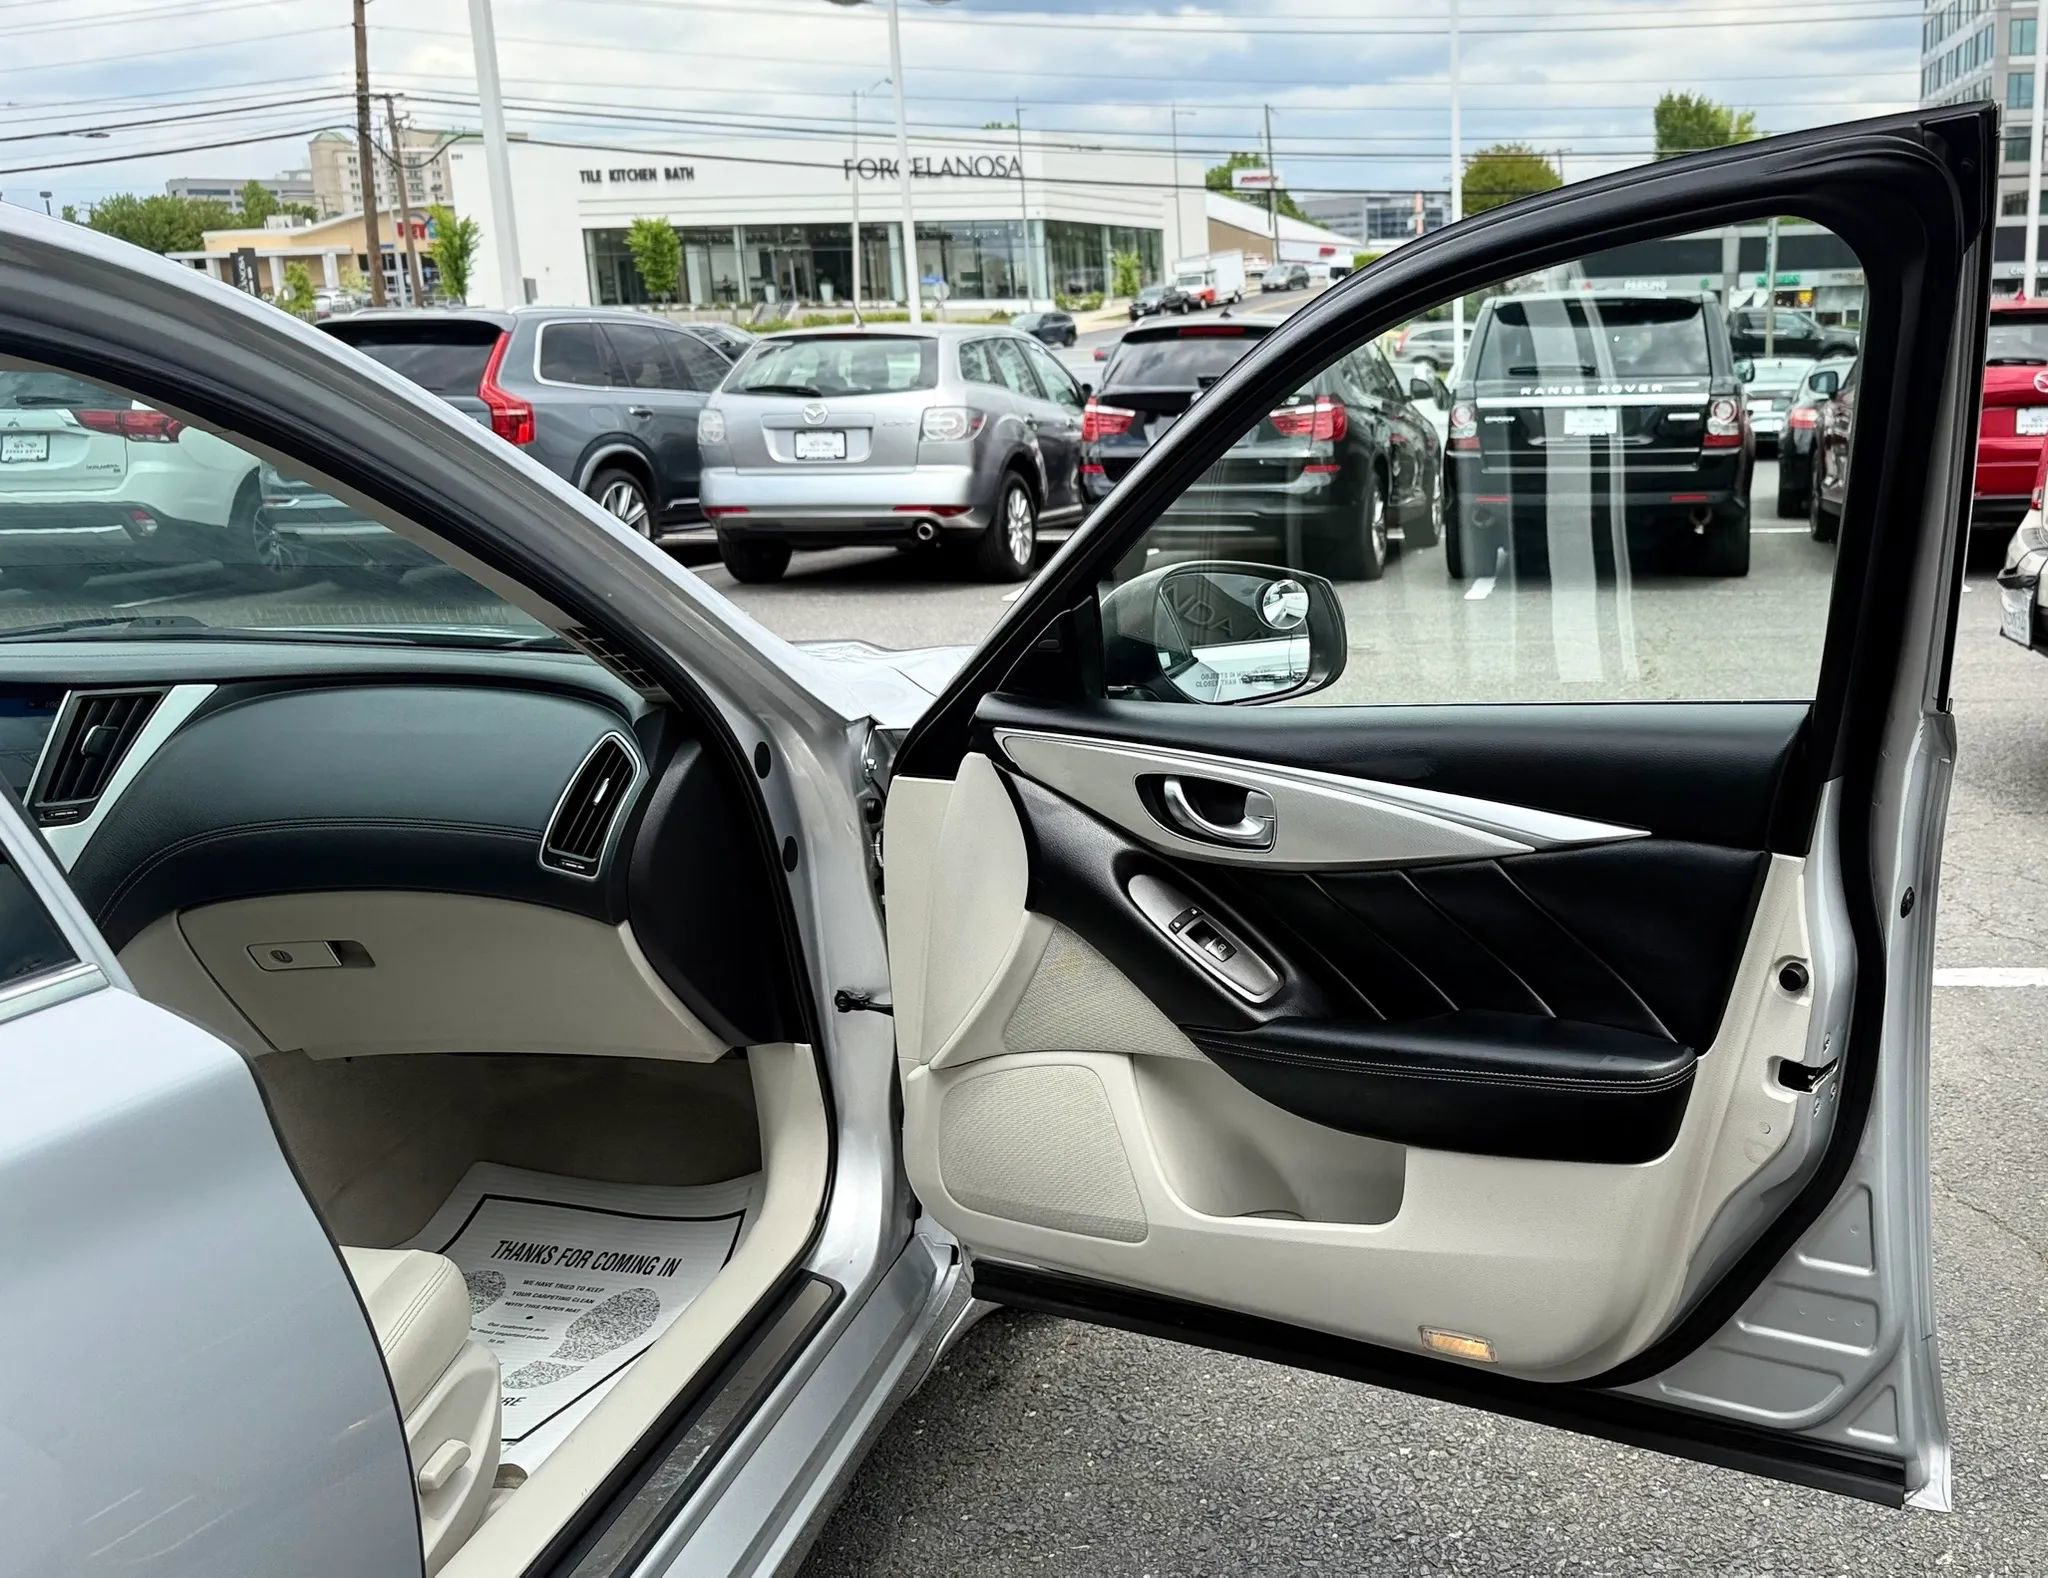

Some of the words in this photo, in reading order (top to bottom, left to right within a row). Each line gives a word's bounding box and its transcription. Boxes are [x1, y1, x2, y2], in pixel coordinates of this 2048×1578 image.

[579, 169, 602, 183] TILE
[608, 168, 657, 182] KITCHEN
[664, 166, 694, 180] BATH
[1520, 386, 1585, 396] RANGE
[1597, 383, 1663, 394] ROVER
[491, 1240, 559, 1265] THANKS
[554, 1247, 594, 1269] FOR
[591, 1251, 660, 1275] COMING
[657, 1257, 682, 1277] IN
[535, 1280, 554, 1288] HAVE
[532, 1292, 571, 1302] CARPETING
[501, 1396, 527, 1406] RE
